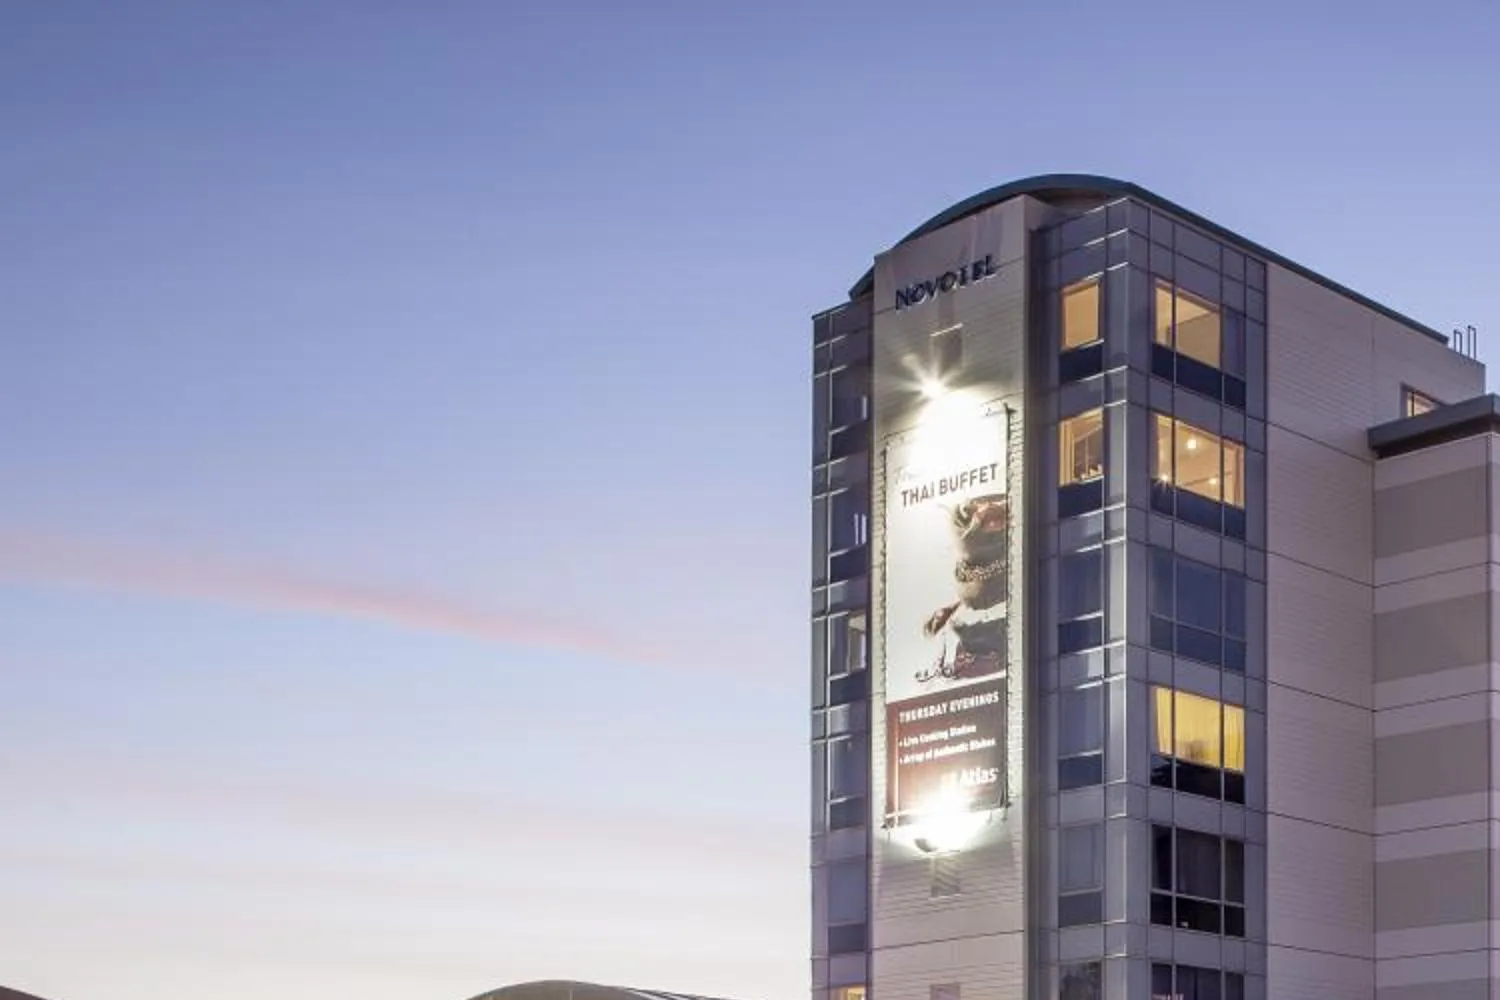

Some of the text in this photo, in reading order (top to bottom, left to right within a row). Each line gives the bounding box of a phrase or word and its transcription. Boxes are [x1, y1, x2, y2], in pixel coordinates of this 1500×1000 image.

[896, 255, 996, 311] NOVOTEL
[901, 482, 935, 507] THAI
[939, 463, 998, 497] BUFFET
[899, 691, 999, 723] THURSDAY EVENINGS
